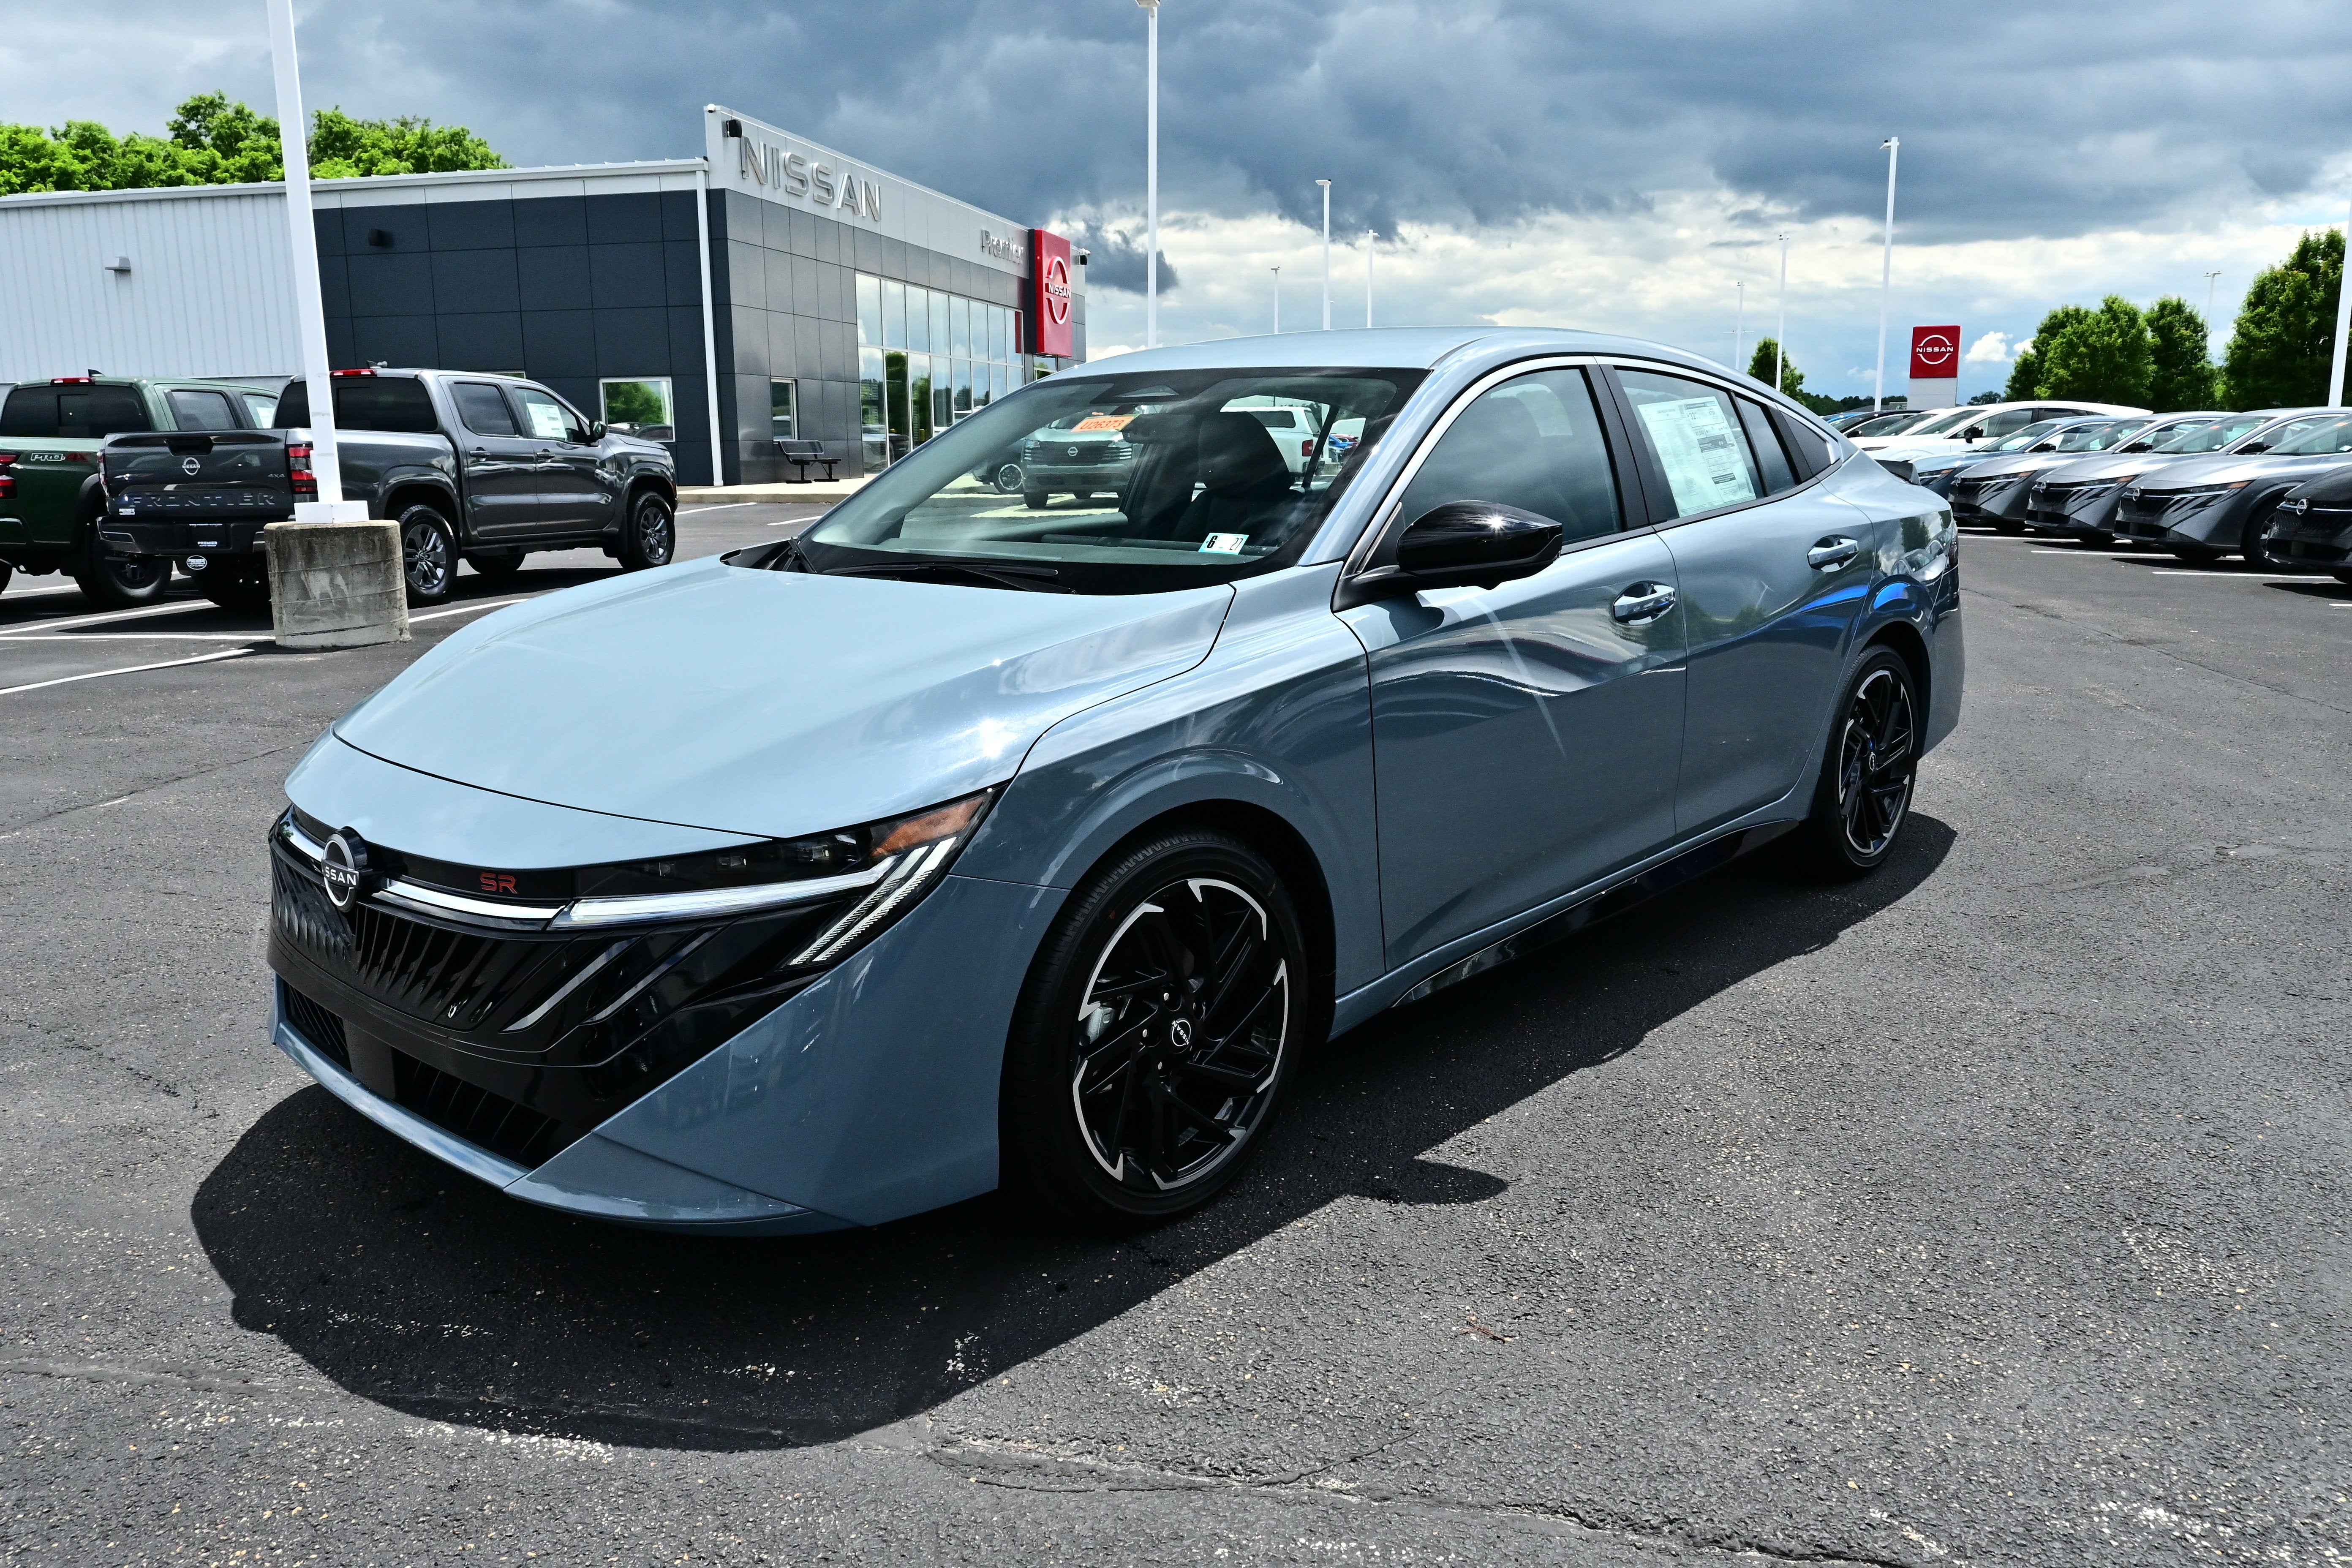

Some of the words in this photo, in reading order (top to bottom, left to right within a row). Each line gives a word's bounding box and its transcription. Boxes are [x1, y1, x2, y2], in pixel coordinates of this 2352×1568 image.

[740, 135, 882, 221] NISSAN
[981, 228, 1023, 264] Premier
[1048, 282, 1071, 299] NISSAN
[1080, 420, 1124, 430] U26373
[1206, 535, 1218, 548] 6
[1229, 537, 1244, 551] 27
[325, 866, 356, 885] SSAN
[480, 872, 518, 894] SR
[1172, 1021, 1190, 1045] NISSAN
